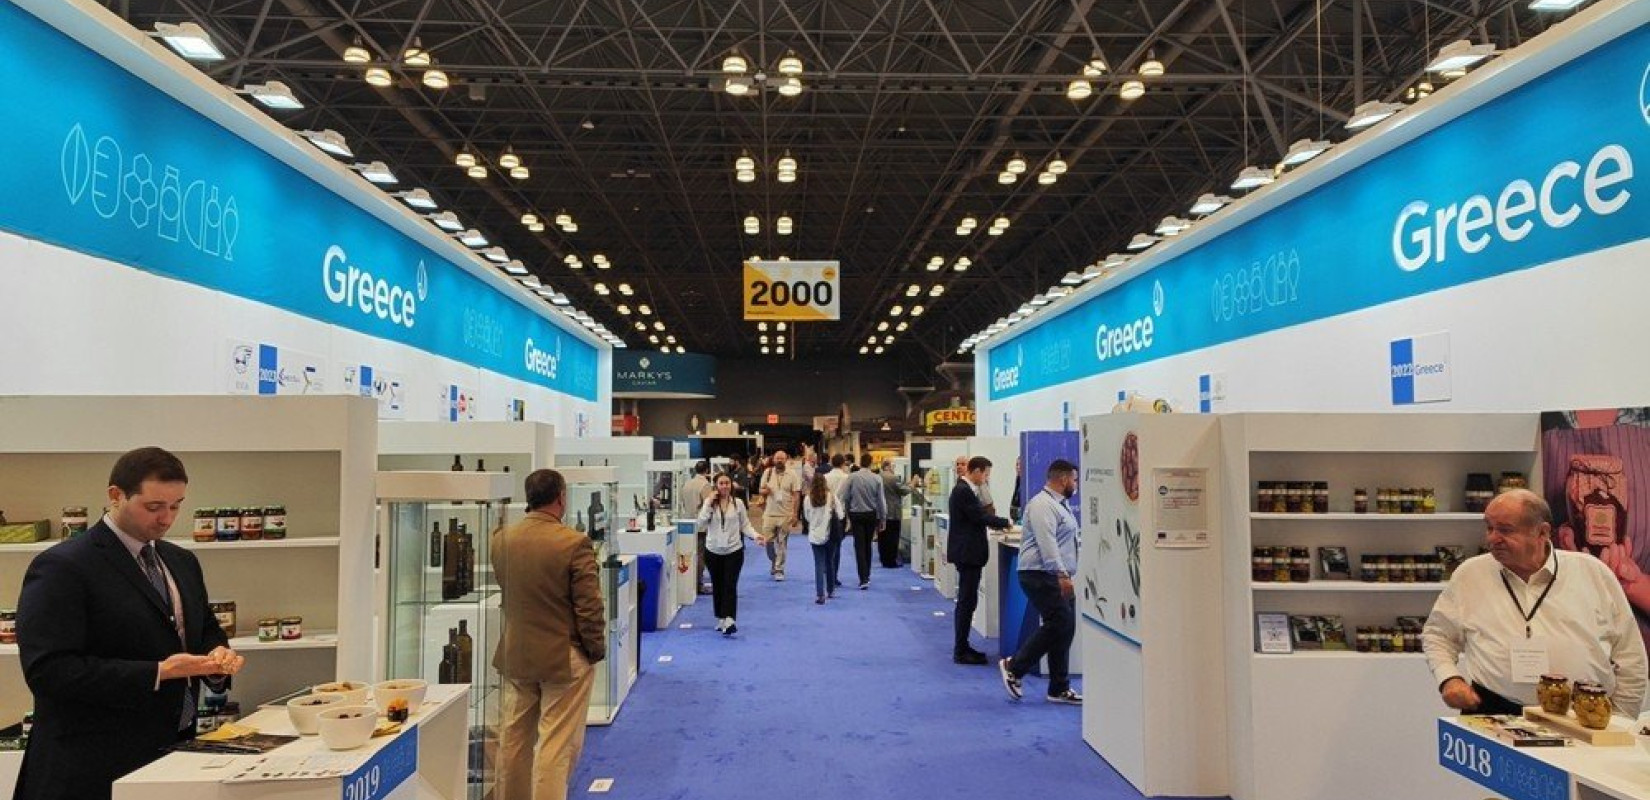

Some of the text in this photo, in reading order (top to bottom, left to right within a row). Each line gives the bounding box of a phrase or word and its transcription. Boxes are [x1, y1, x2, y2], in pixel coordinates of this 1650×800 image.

[1391, 145, 1633, 272] Greece
[323, 244, 417, 329] Greece
[750, 280, 832, 307] 2000
[1096, 314, 1153, 363] Greece
[523, 339, 558, 379] Greece
[1415, 363, 1445, 376] Greece
[993, 367, 1019, 393] Greece
[1442, 731, 1493, 778] 2018
[345, 763, 381, 800] 2019
